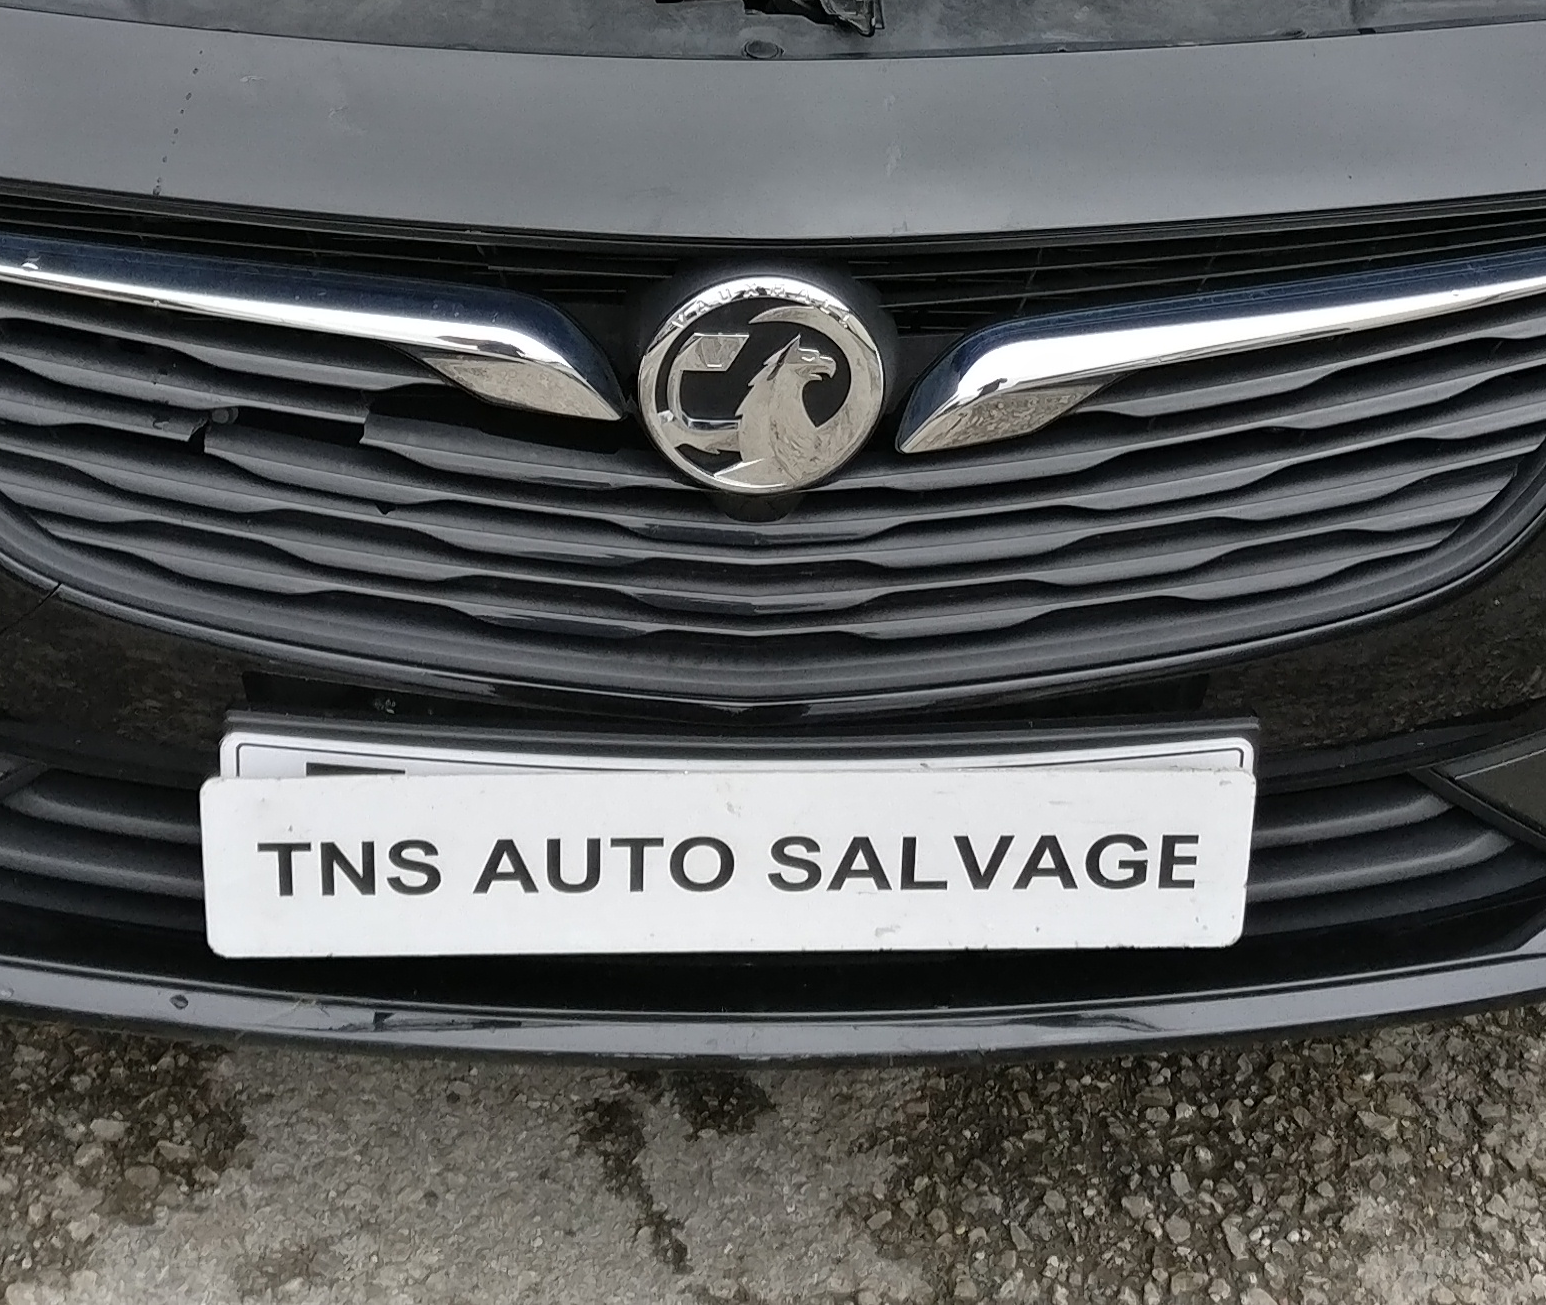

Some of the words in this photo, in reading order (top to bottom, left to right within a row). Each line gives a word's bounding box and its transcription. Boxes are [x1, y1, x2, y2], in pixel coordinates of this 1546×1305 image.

[258, 840, 441, 895] TNS
[474, 837, 734, 892] AUTO
[769, 835, 1198, 890] SALVAGE
